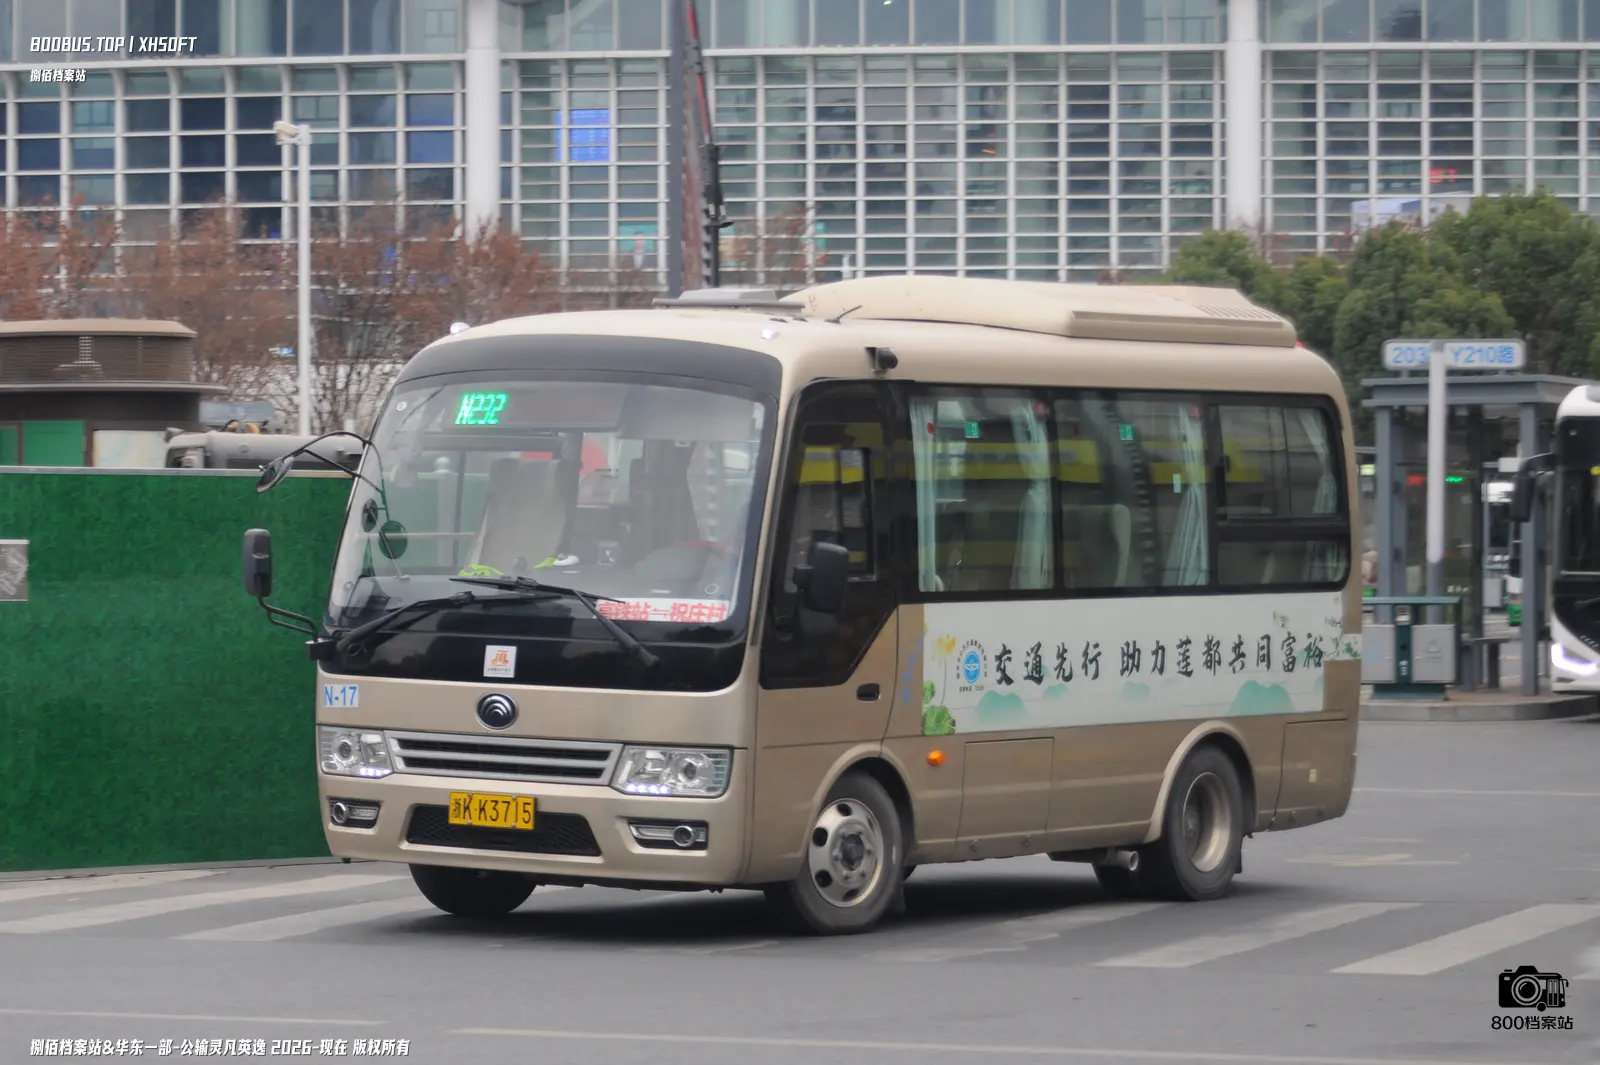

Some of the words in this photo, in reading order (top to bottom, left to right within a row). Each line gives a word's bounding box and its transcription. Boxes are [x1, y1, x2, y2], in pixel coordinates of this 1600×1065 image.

[454, 393, 507, 425] N232
[994, 640, 1102, 686] 交通先行
[1120, 631, 1324, 678] 助力莲都共同富裕
